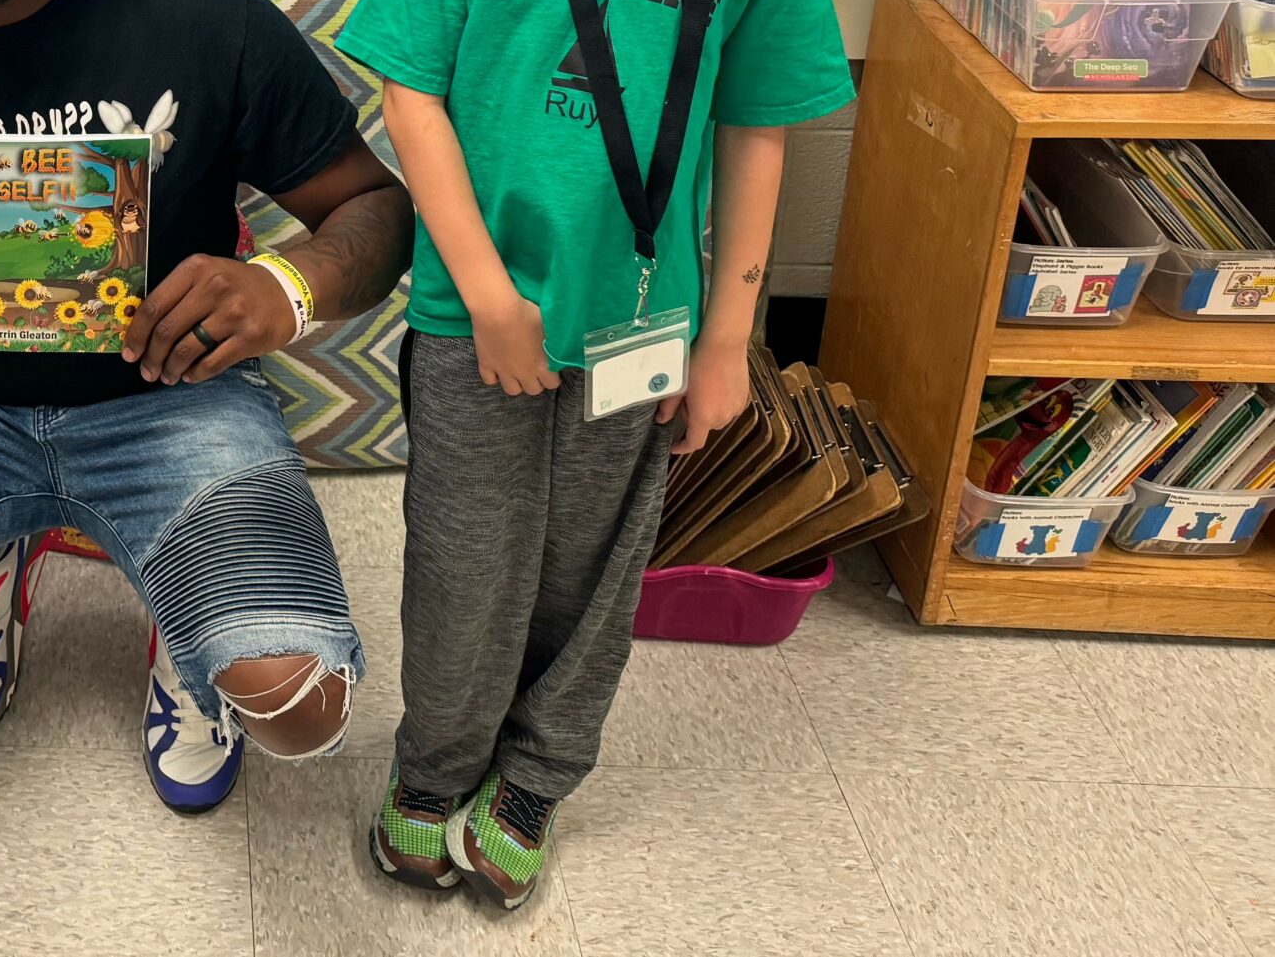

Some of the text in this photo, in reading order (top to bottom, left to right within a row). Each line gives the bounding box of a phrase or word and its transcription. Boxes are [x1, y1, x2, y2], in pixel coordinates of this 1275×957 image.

[1085, 63, 1099, 71] The
[1101, 63, 1120, 72] Deep
[21, 147, 74, 175] BEE
[19, 330, 57, 341] Gleaton
